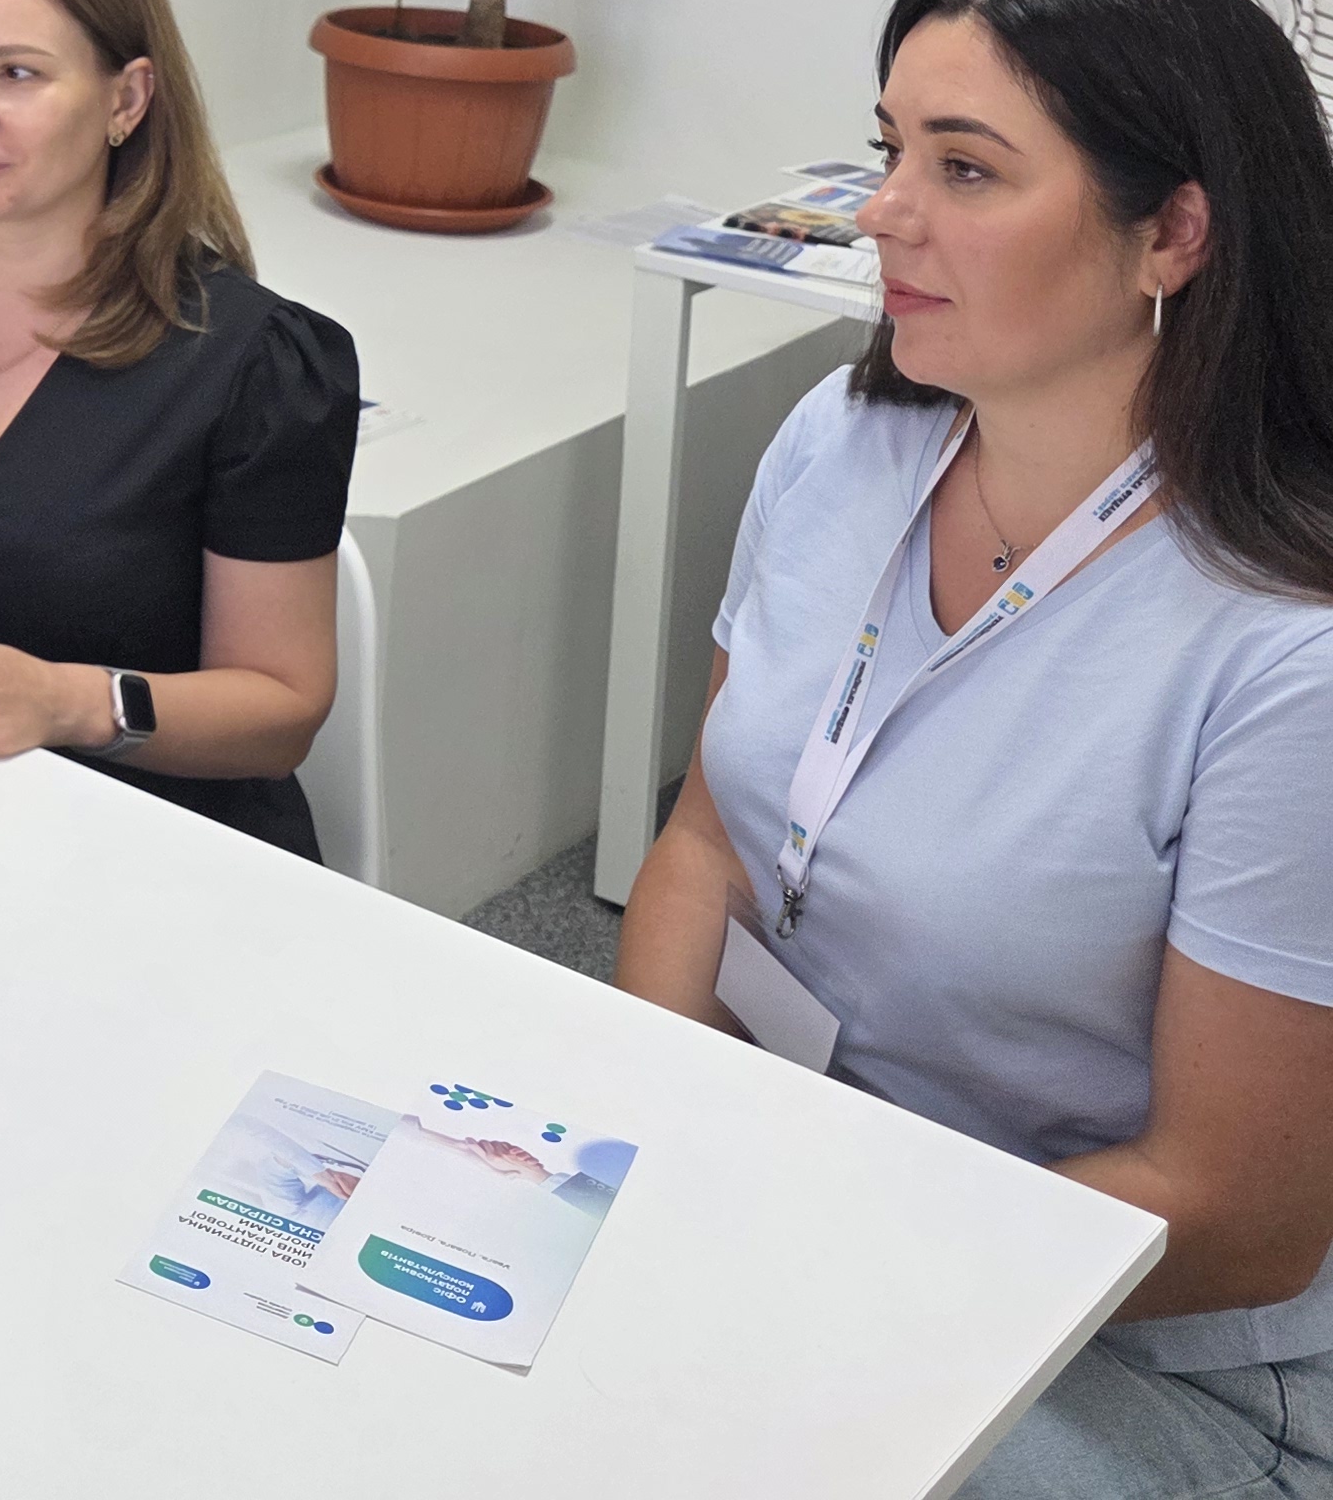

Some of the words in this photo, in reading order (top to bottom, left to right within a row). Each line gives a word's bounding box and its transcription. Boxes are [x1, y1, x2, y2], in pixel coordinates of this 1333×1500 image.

[178, 1215, 267, 1254] ПІДТРИМКА
[189, 1210, 273, 1246] ГРАНТОВОЇ
[380, 1250, 475, 1291] консультантів
[393, 1263, 470, 1297] податкових
[432, 1287, 467, 1304] Офіс
